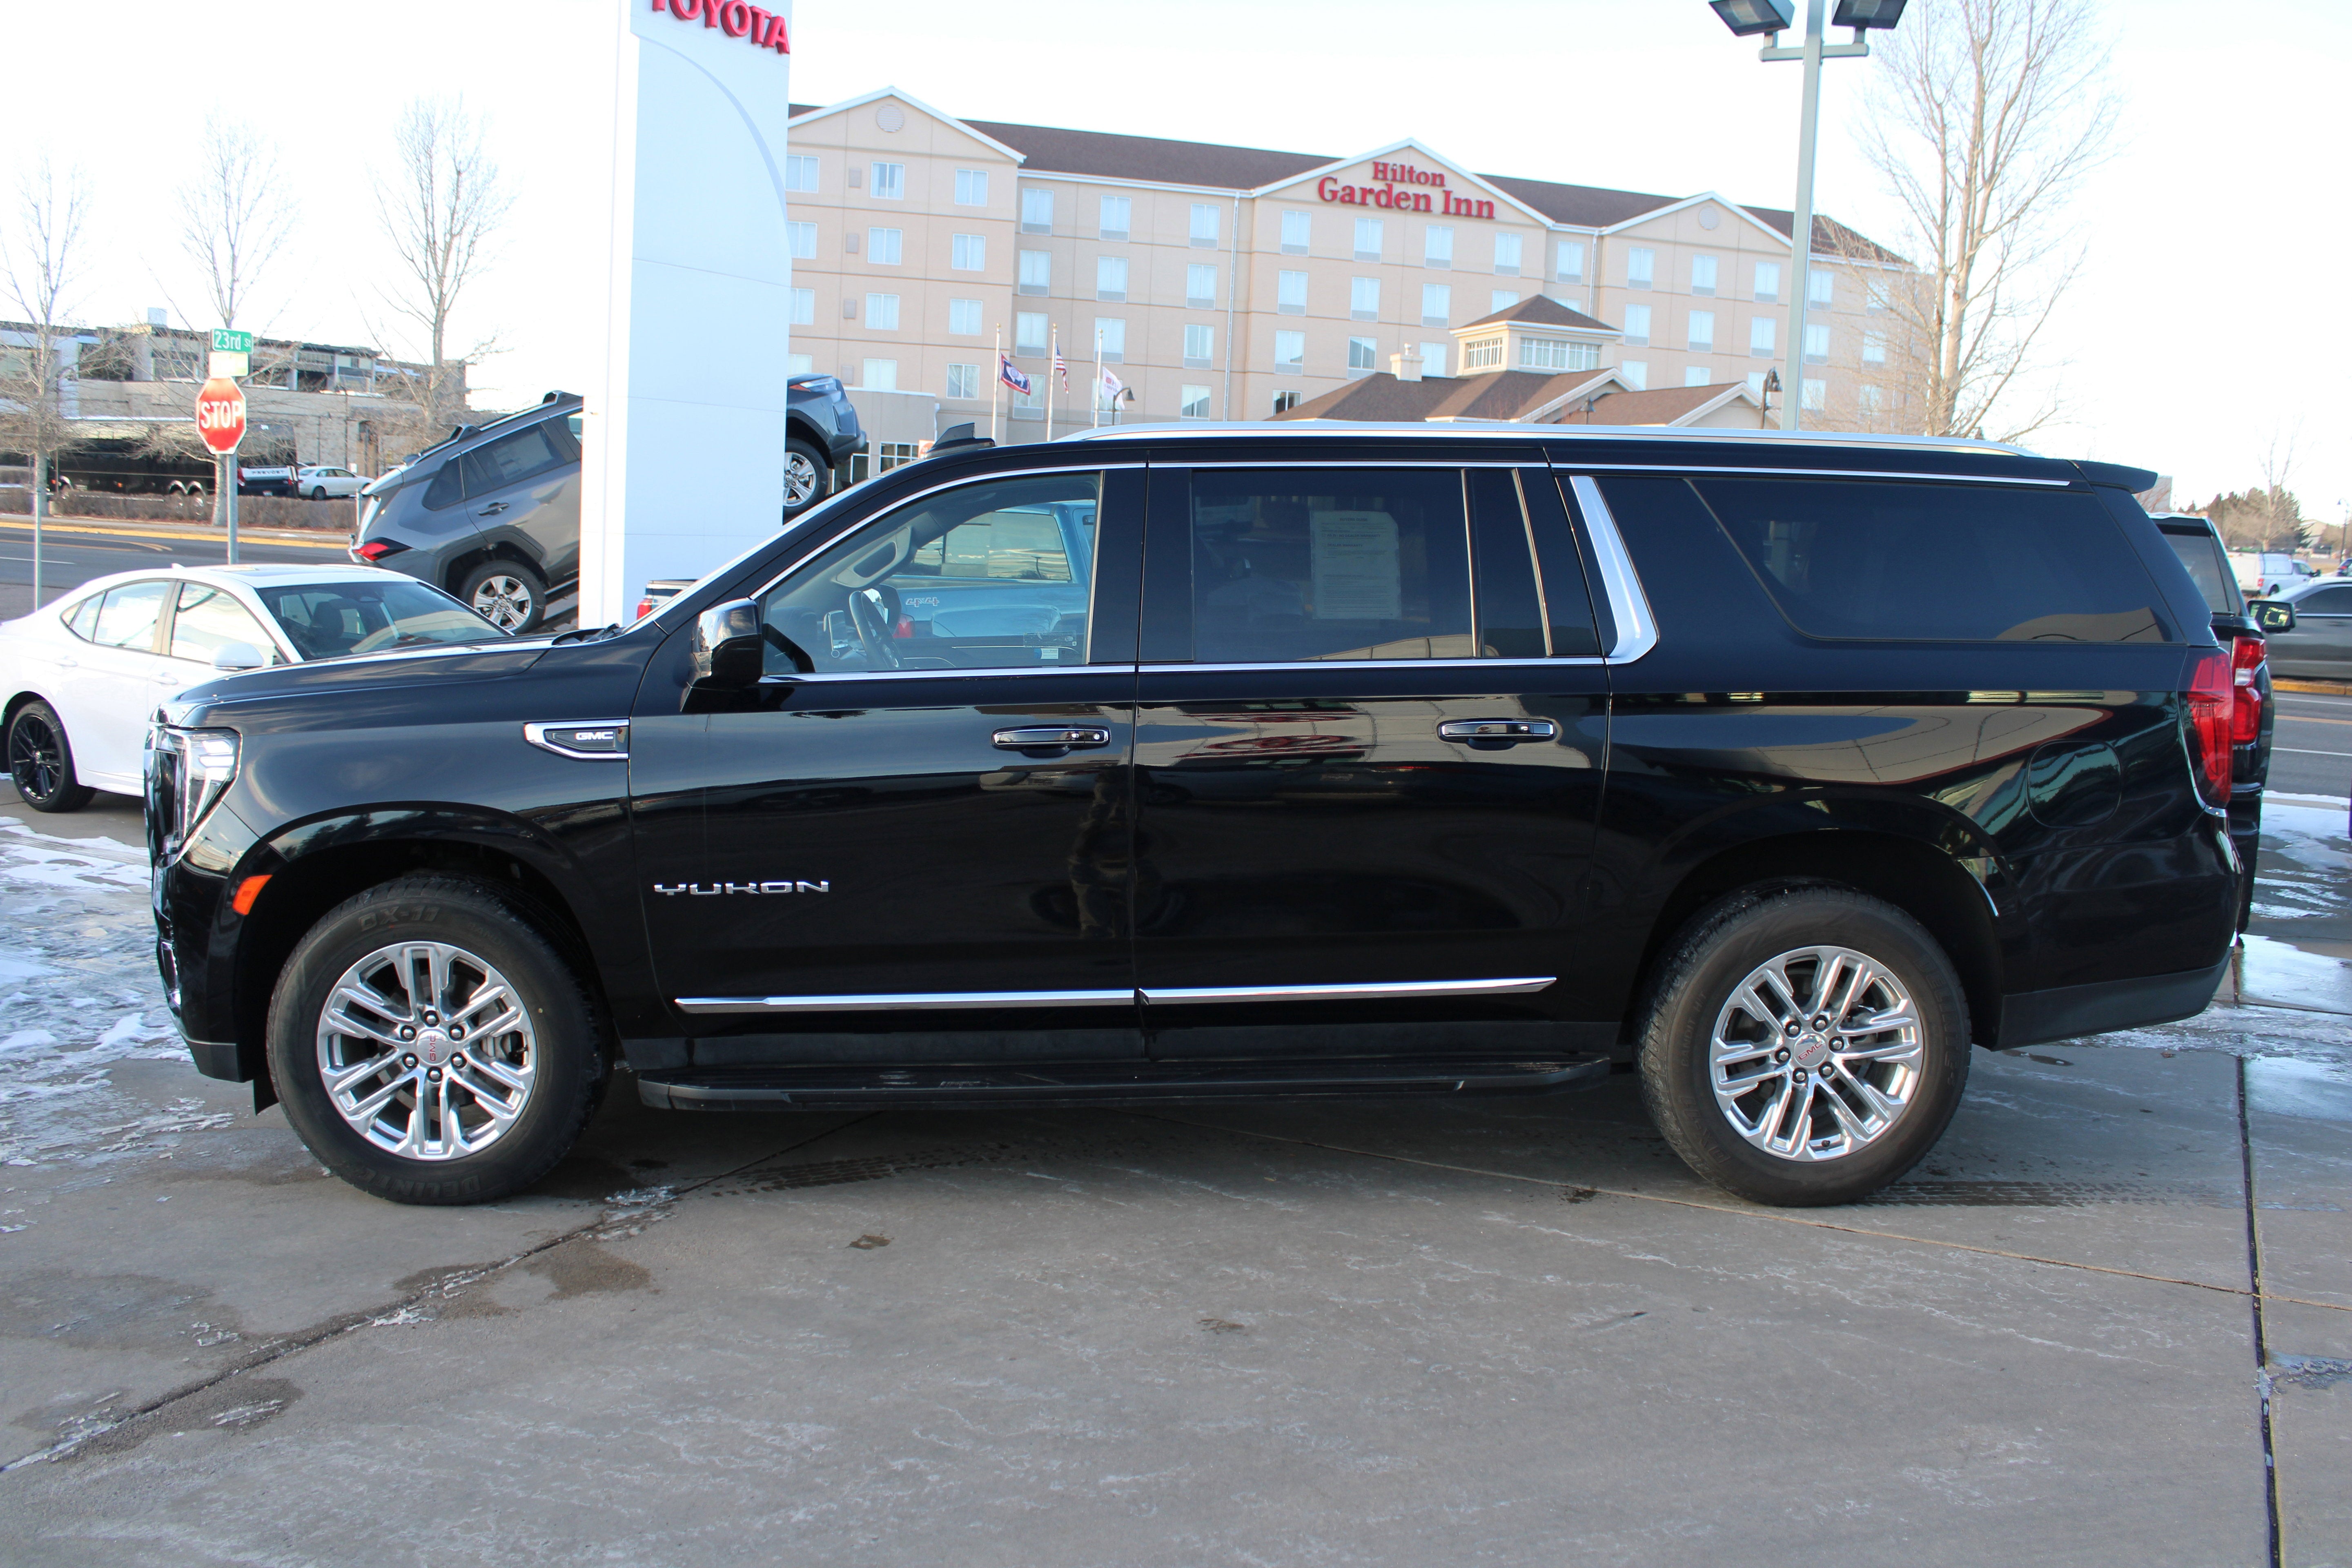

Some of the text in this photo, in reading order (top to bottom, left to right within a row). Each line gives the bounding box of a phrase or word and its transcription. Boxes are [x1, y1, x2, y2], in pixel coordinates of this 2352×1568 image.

[1372, 161, 1446, 187] Hilton
[1318, 176, 1495, 219] Garden Inn
[214, 330, 252, 350] 23rd St
[200, 400, 243, 429] STOP
[575, 731, 614, 740] GMC
[654, 881, 829, 896] YUKON
[1798, 1040, 1823, 1060] GMC
